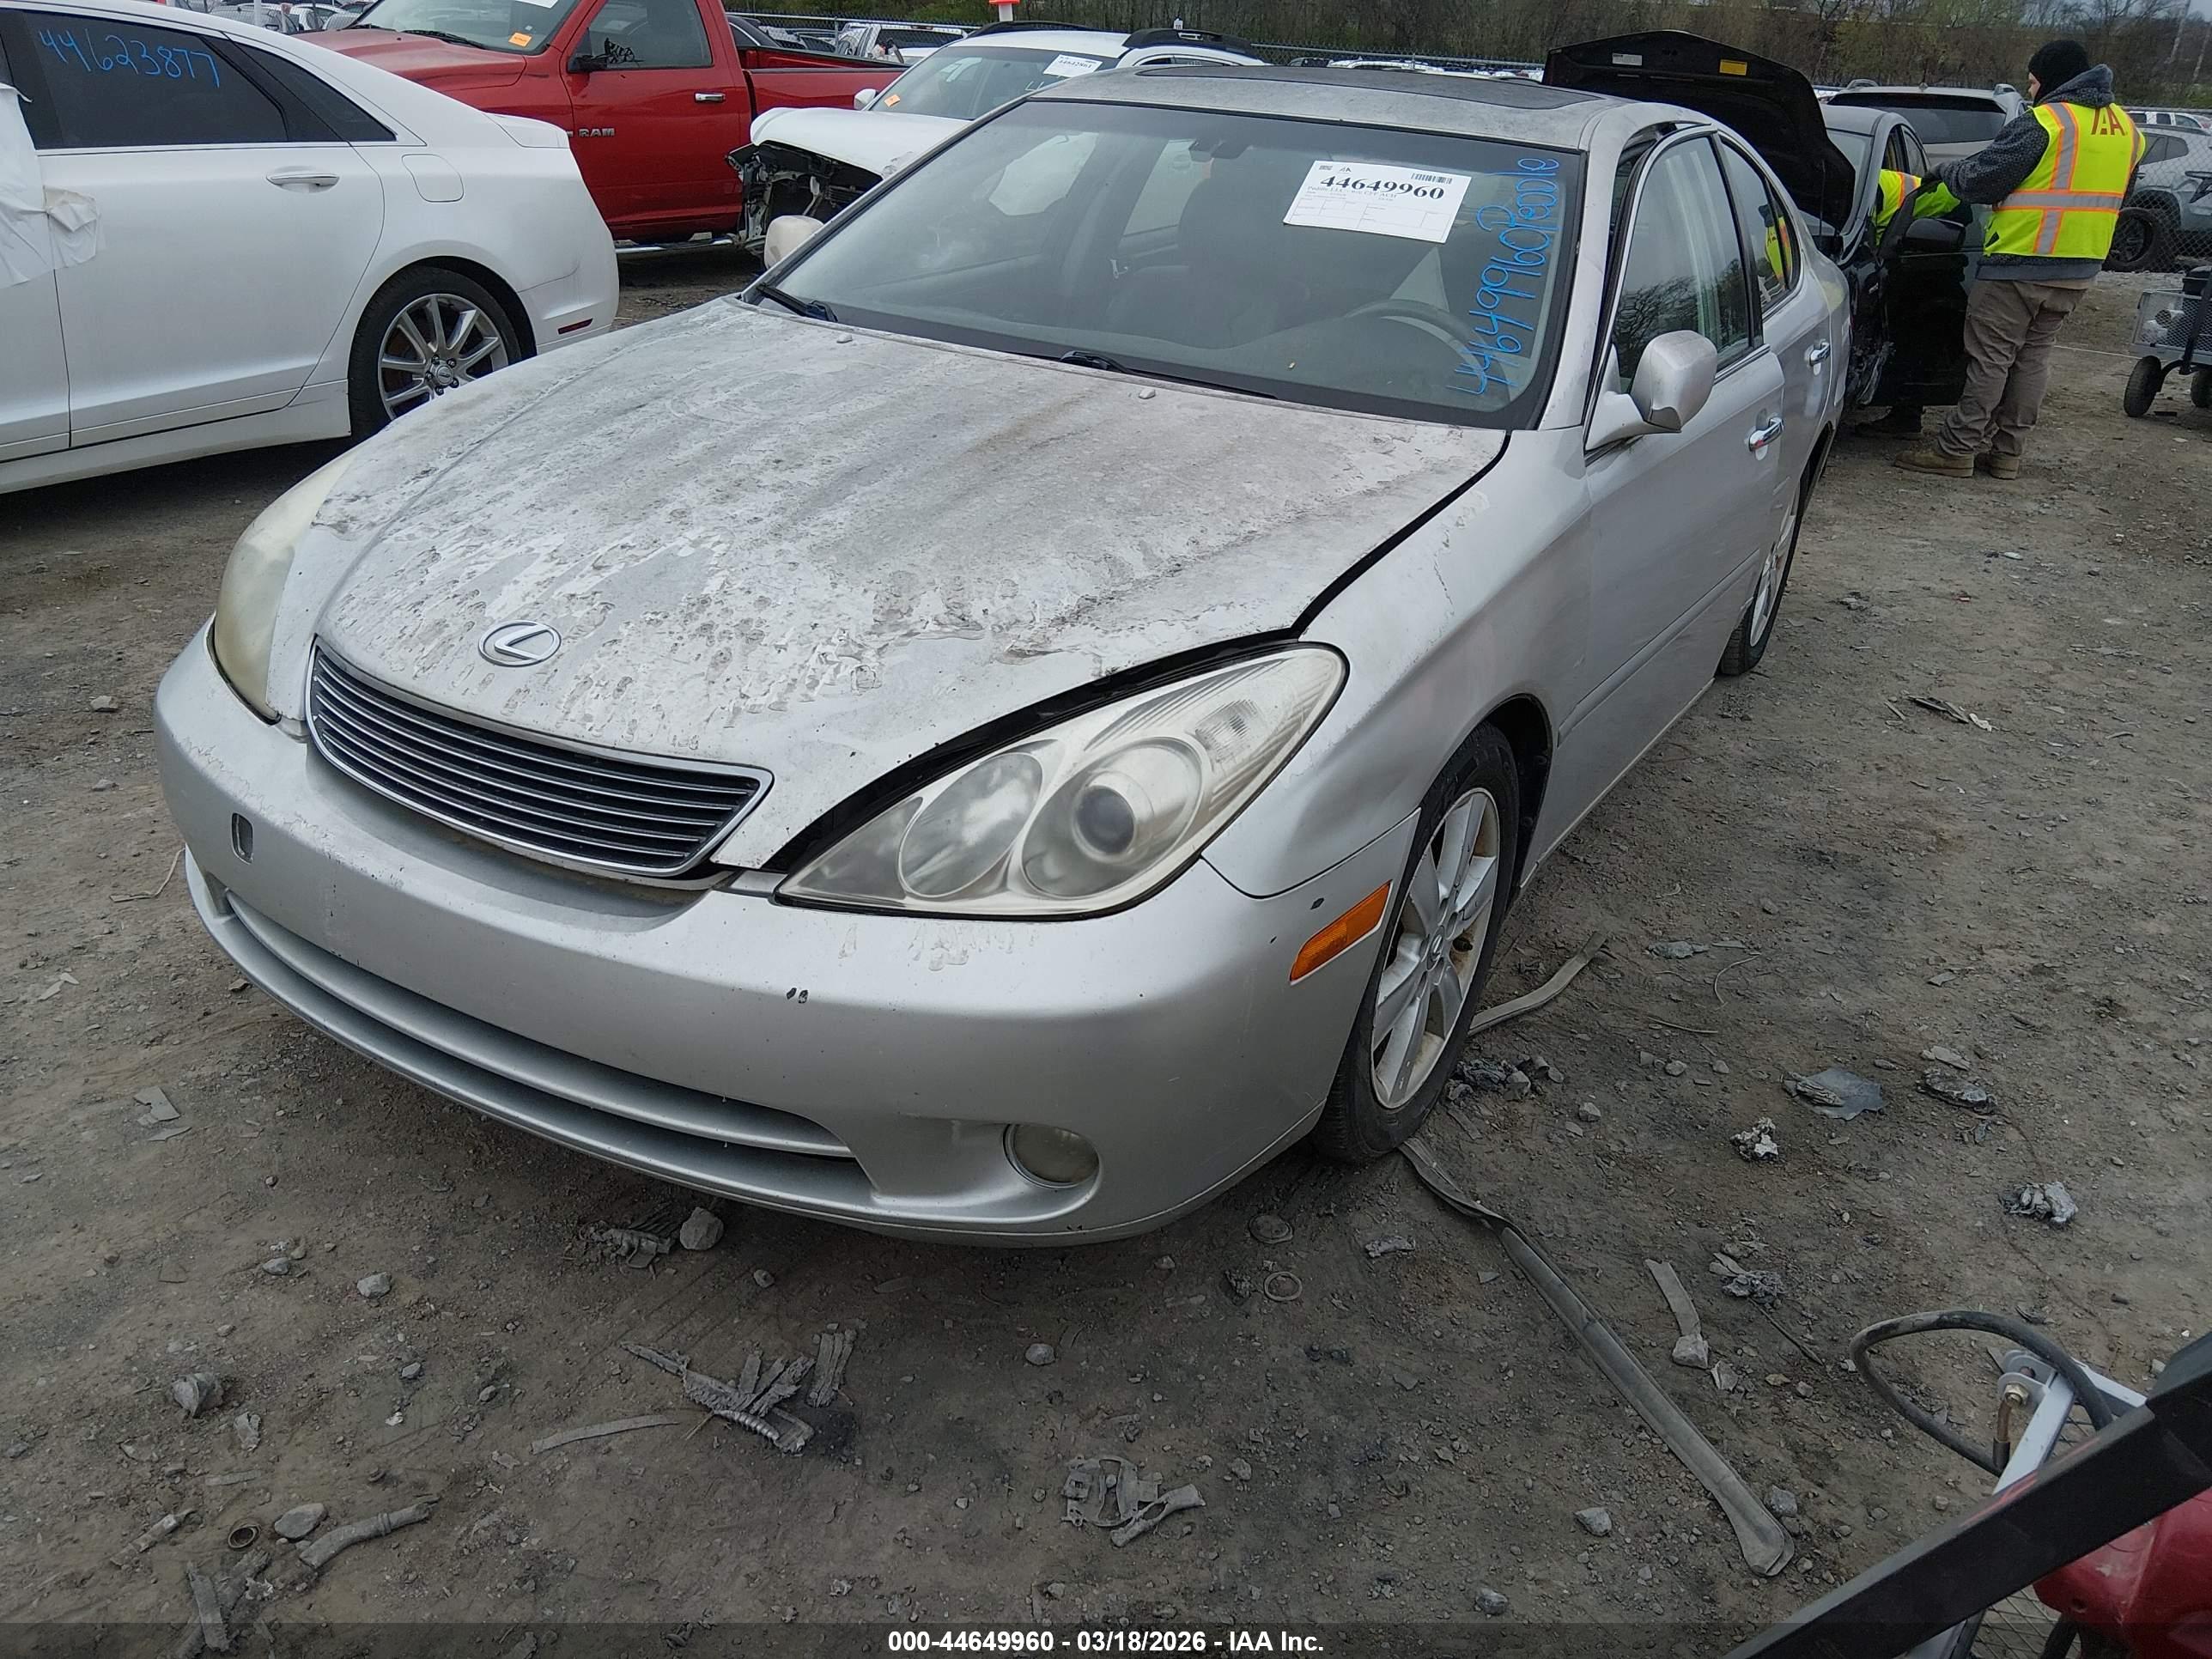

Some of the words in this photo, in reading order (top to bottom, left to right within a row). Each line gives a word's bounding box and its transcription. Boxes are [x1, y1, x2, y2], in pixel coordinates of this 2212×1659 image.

[39, 28, 220, 88] 44623877
[579, 128, 615, 137] RAM
[1320, 175, 1444, 199] 44649960
[1445, 227, 1551, 395] 44649960
